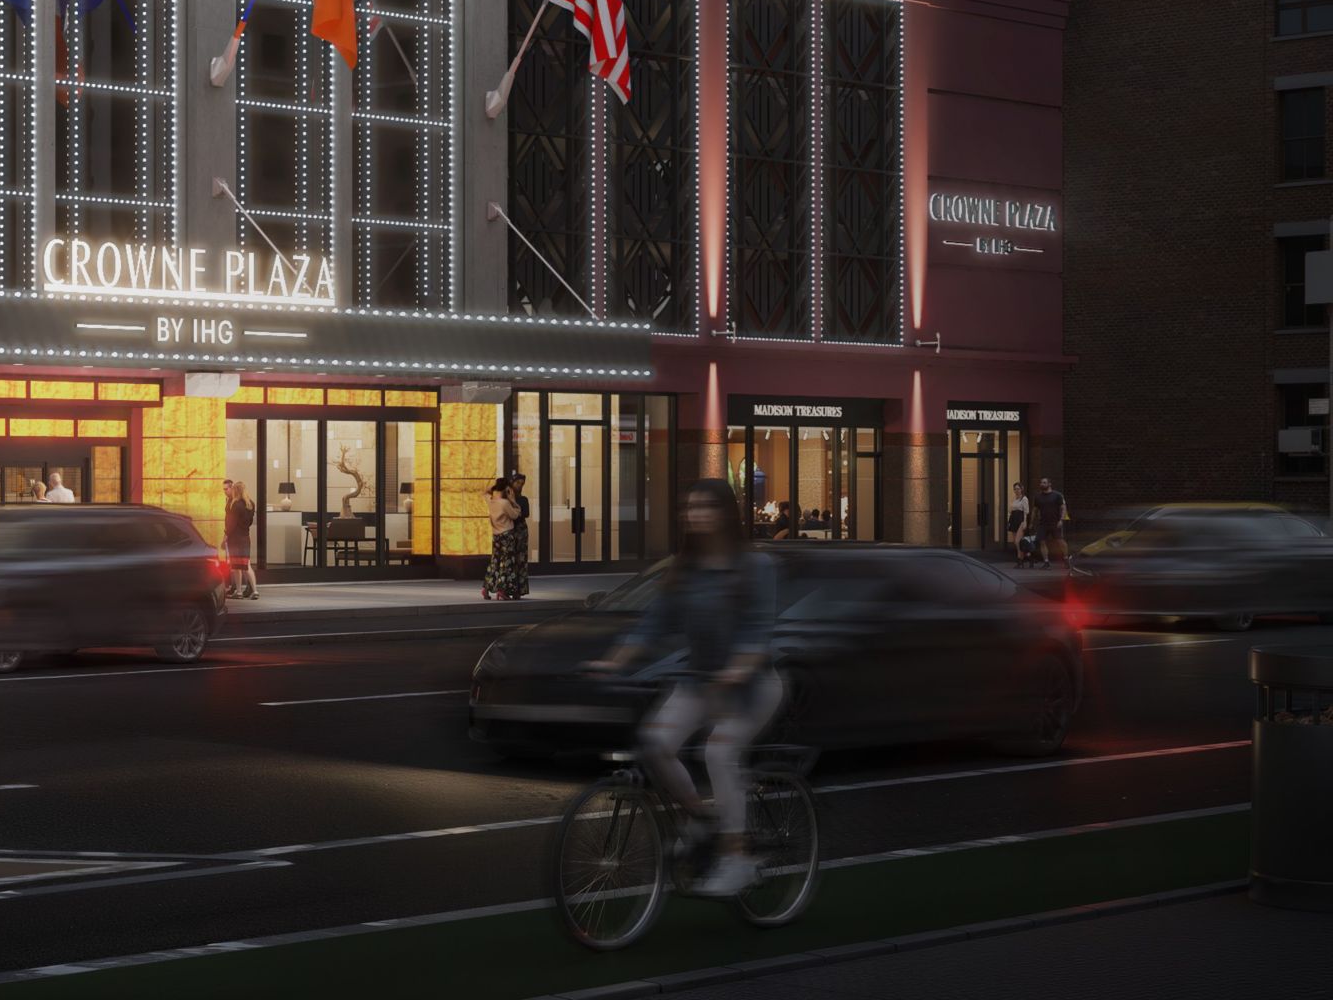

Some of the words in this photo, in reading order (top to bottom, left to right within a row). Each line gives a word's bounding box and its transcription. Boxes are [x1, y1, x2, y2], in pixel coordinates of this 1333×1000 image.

[929, 192, 1000, 226] CROWNE
[1005, 200, 1056, 232] PLAZA
[43, 238, 208, 292] CROWNE
[225, 249, 335, 299] PLAZA
[156, 316, 185, 343] BY
[192, 318, 234, 345] IHG
[753, 404, 793, 417] MADISON
[794, 405, 843, 418] TREASURES
[946, 409, 977, 420] ADISON
[977, 410, 1020, 422] TREASURES
